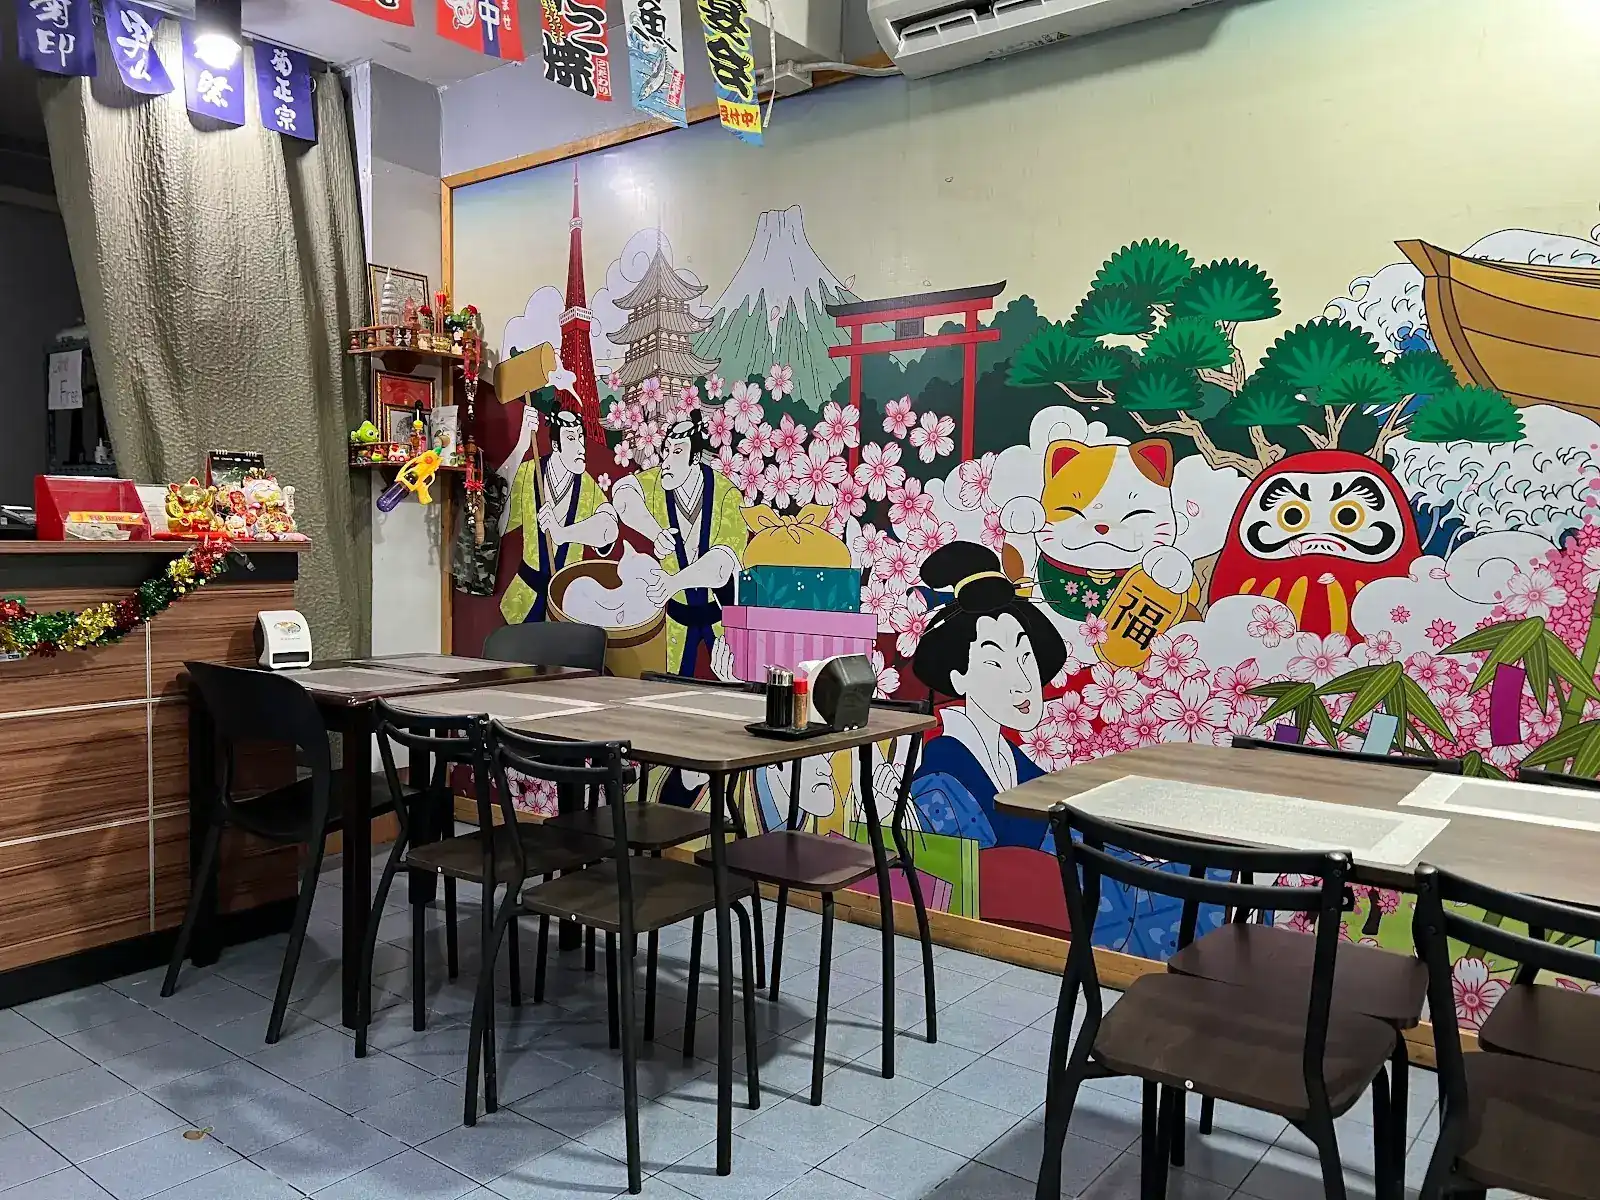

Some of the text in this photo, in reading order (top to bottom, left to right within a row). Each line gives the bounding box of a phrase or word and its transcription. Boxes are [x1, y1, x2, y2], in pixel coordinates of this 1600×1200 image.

[270, 48, 298, 132] 菊正宗
[1111, 585, 1172, 651] 福
